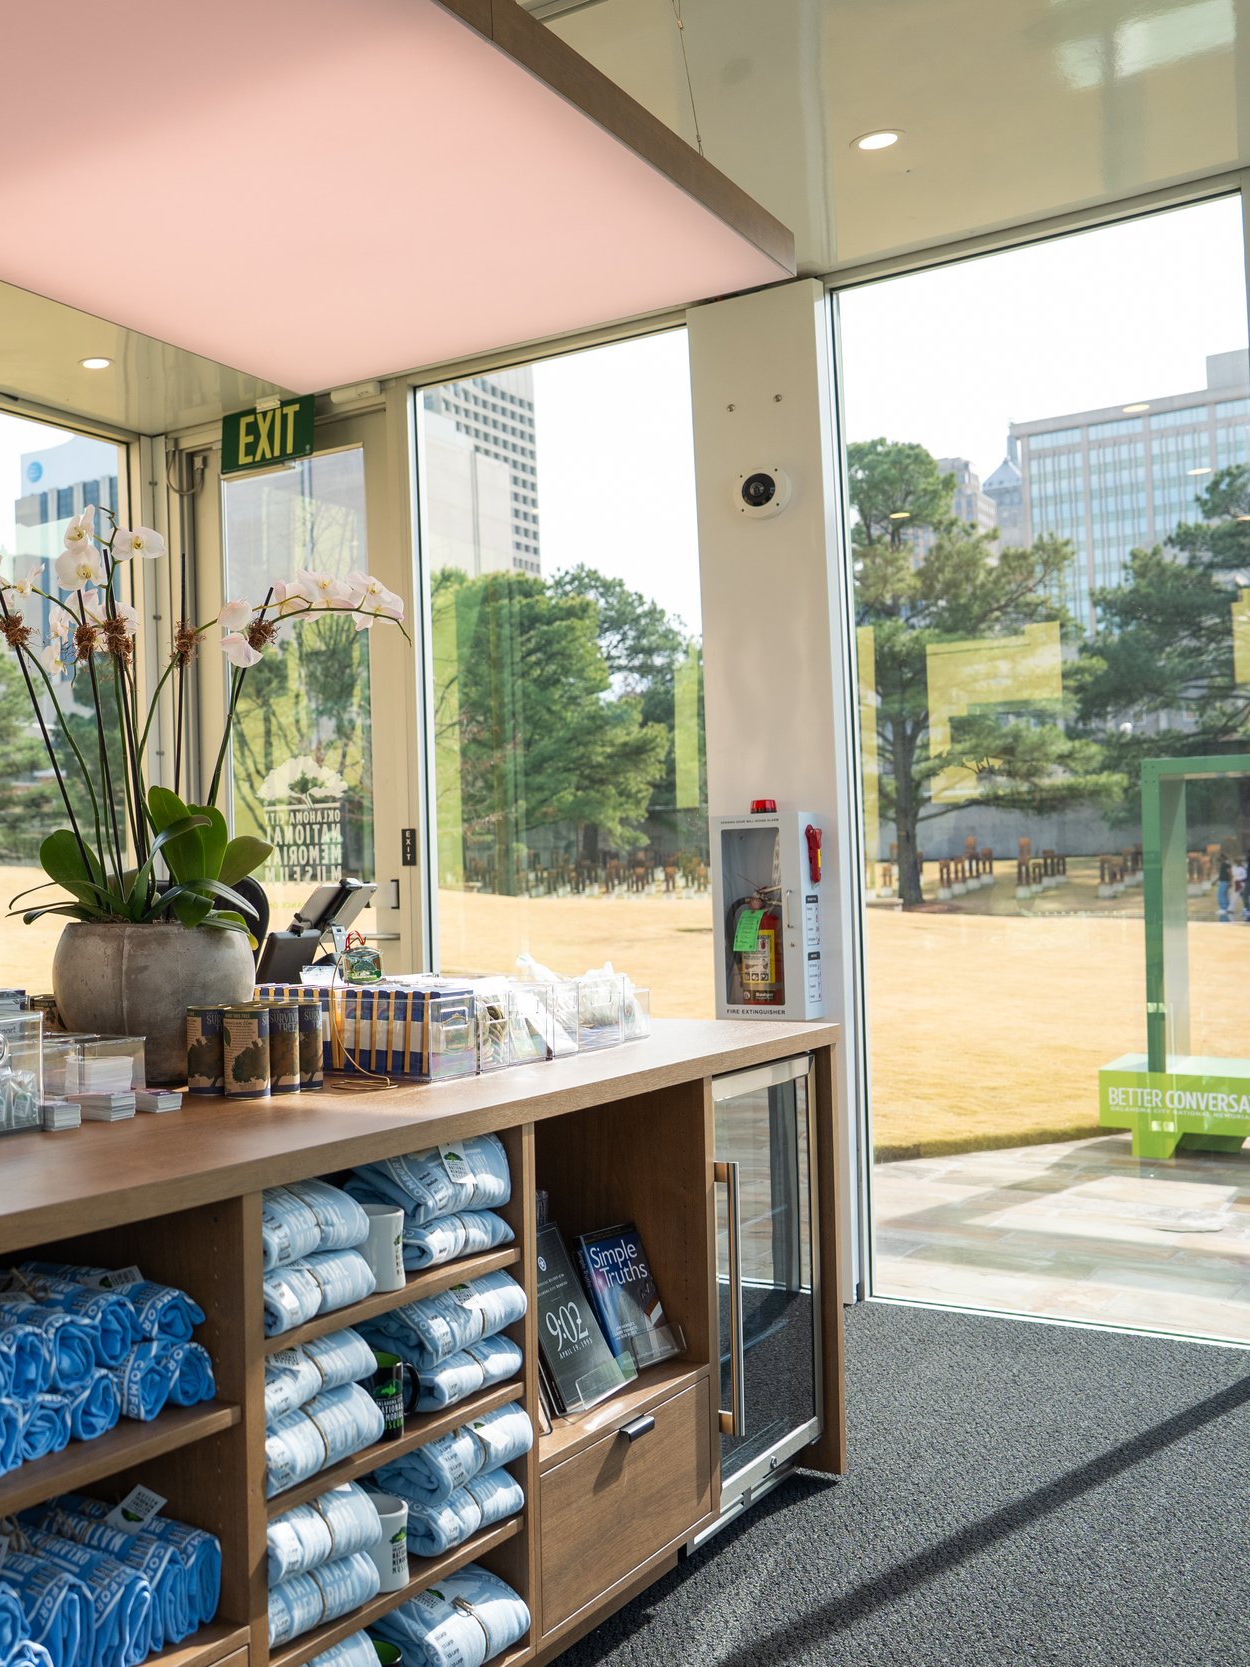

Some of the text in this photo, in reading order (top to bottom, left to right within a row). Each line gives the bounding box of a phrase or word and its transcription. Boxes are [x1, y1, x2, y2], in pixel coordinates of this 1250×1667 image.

[238, 404, 300, 465] EXIT
[1108, 1087, 1250, 1114] BETTER CONVERSA
[392, 1161, 428, 1202] COMFOR
[590, 1239, 638, 1269] Simple
[599, 1261, 648, 1289] Truths
[546, 1302, 589, 1352] 9:02
[559, 1347, 571, 1360] APRIL
[582, 1337, 593, 1349] 1995
